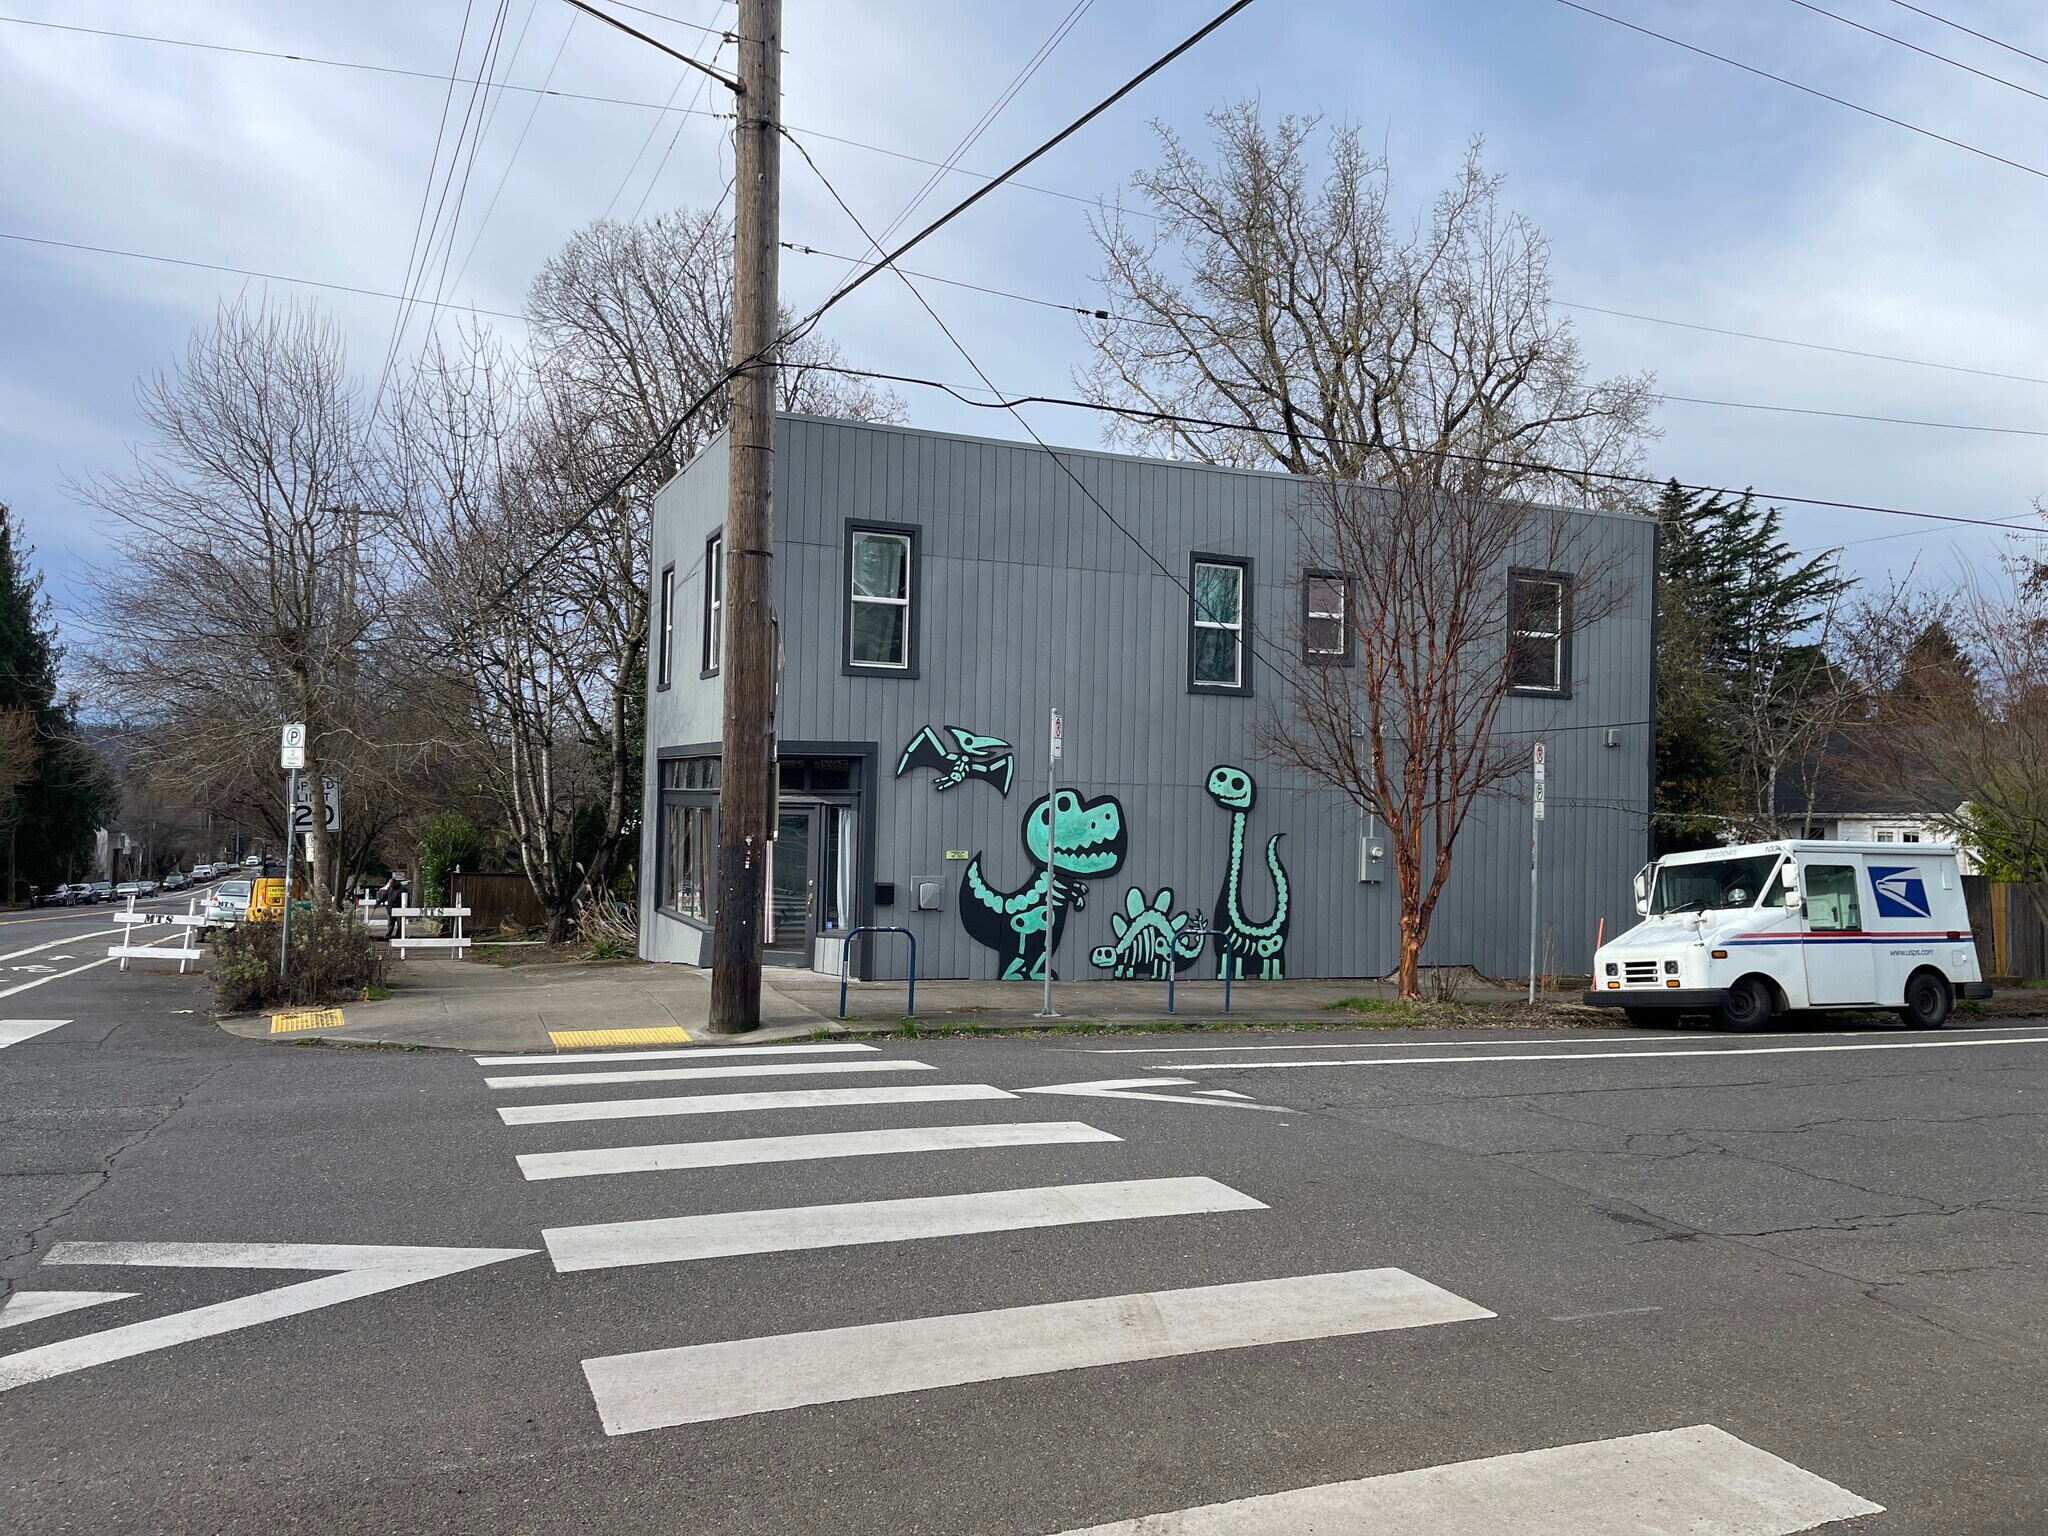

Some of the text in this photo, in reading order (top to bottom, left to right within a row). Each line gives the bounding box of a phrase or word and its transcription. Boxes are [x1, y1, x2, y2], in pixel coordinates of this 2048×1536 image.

[297, 792, 330, 802] LIT
[419, 907, 444, 916] MTS
[144, 914, 174, 924] MTS
[1890, 949, 1934, 957] www.usps.com
